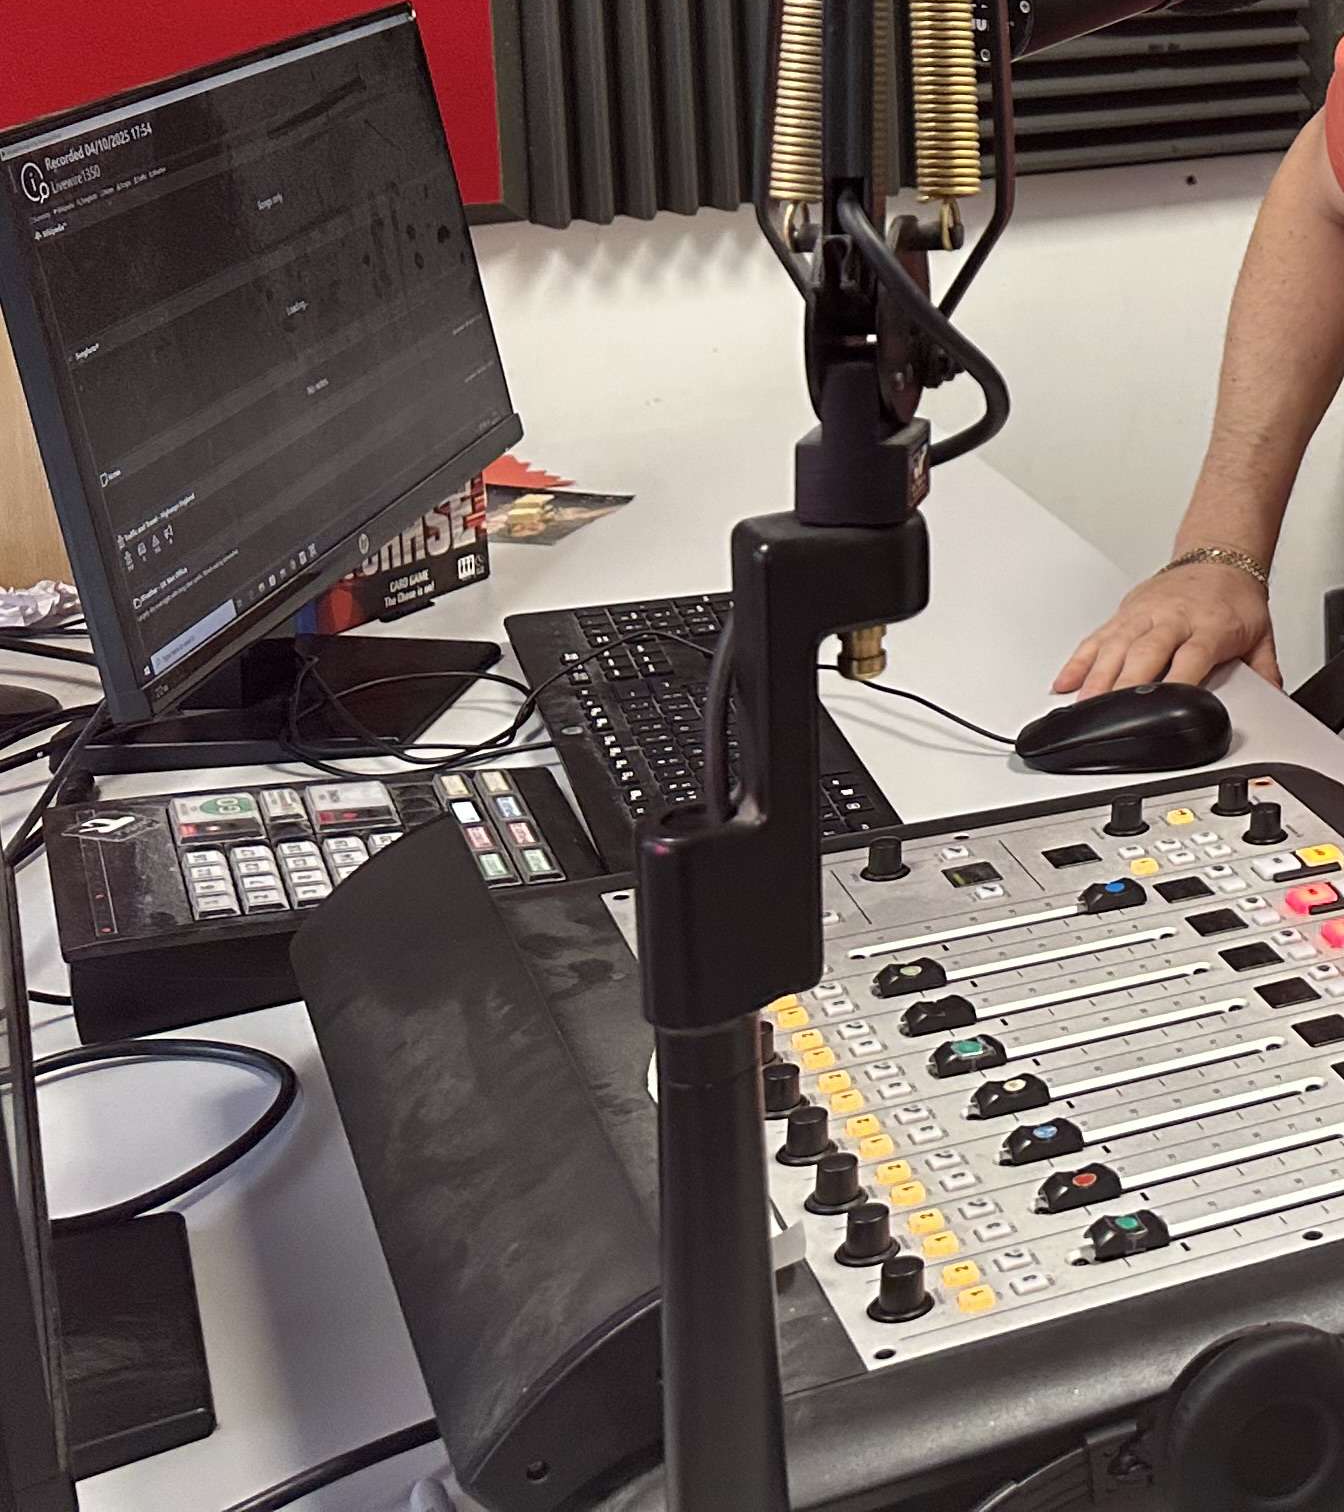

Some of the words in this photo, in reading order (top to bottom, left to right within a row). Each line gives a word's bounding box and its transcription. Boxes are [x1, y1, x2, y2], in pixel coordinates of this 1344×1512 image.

[44, 145, 84, 172] Recorded
[84, 129, 131, 157] 04/10/2025
[131, 121, 153, 140] 17:54
[410, 569, 429, 586] GAME
[384, 596, 397, 609] The
